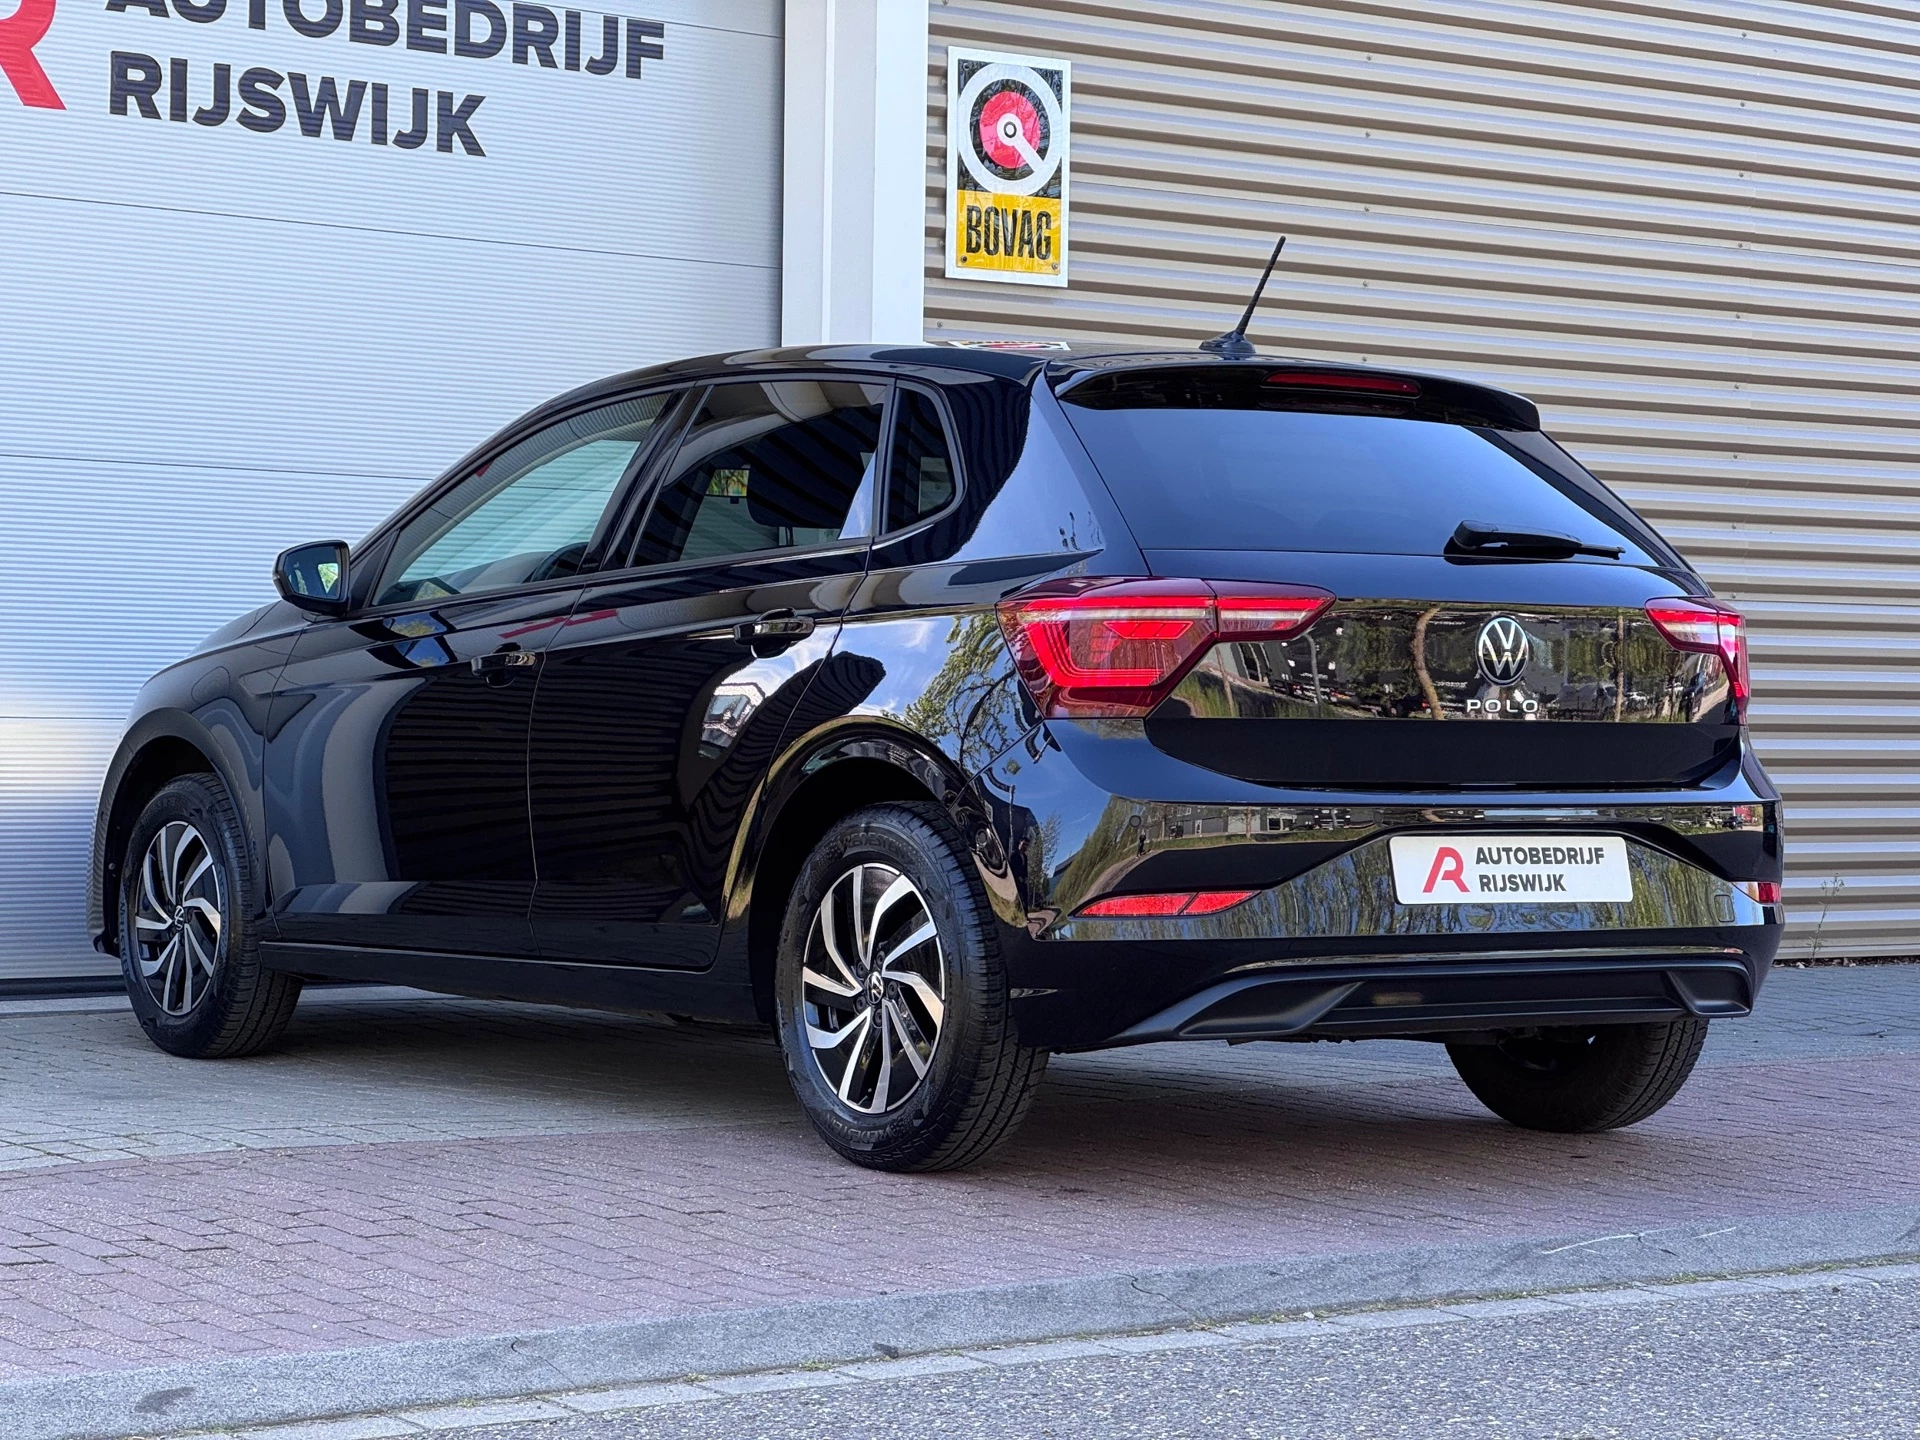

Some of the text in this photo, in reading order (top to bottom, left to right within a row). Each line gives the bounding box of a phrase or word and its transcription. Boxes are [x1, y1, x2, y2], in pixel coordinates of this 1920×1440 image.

[105, 0, 665, 80] OBEDRIJF
[109, 50, 486, 158] RIJSWIJK
[966, 205, 1052, 260] BOVAG
[1465, 698, 1539, 713] POLO
[1475, 846, 1605, 866] AUTOBEDRIJF
[1478, 873, 1567, 893] RIJSWIJK
